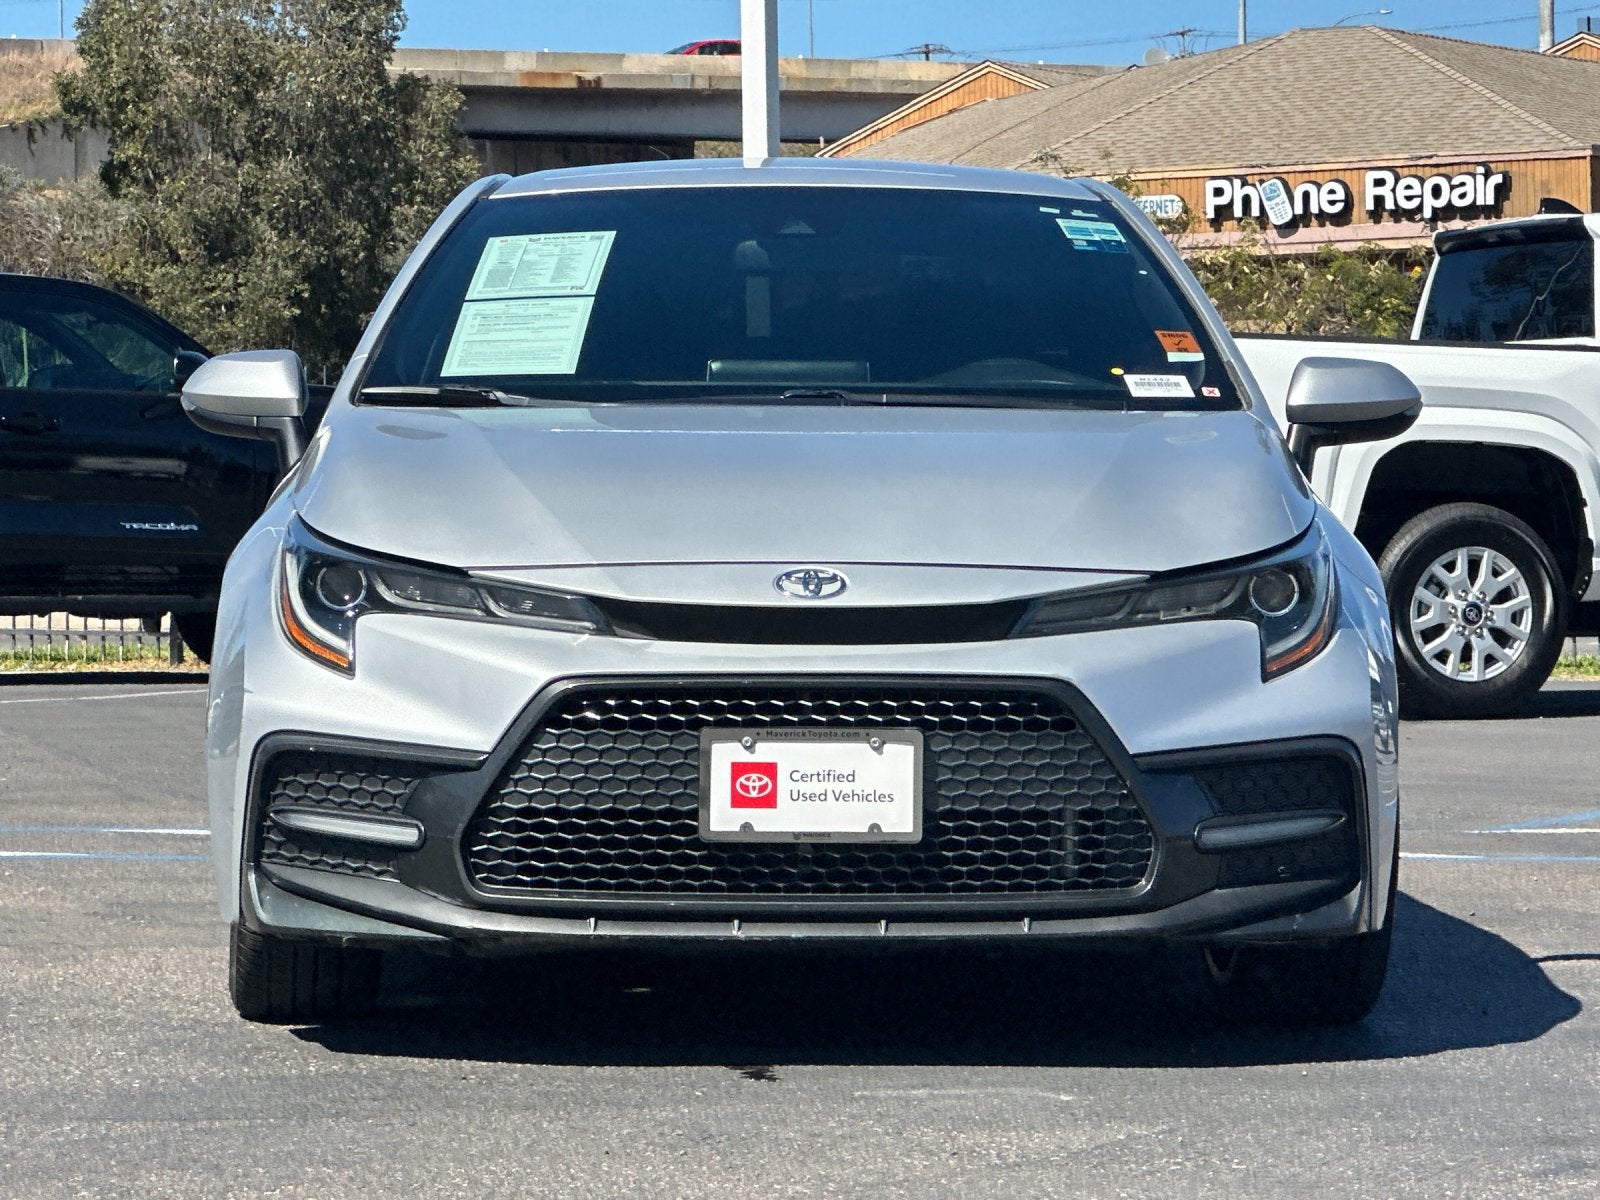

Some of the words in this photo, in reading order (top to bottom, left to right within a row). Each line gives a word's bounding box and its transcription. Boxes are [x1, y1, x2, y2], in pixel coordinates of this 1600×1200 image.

[1365, 165, 1503, 219] Repair
[120, 522, 199, 531] TACOMA
[765, 729, 860, 739] MaverickToyota.com
[789, 769, 856, 783] Certified
[789, 789, 828, 802] Used
[832, 789, 894, 803] Vehicles
